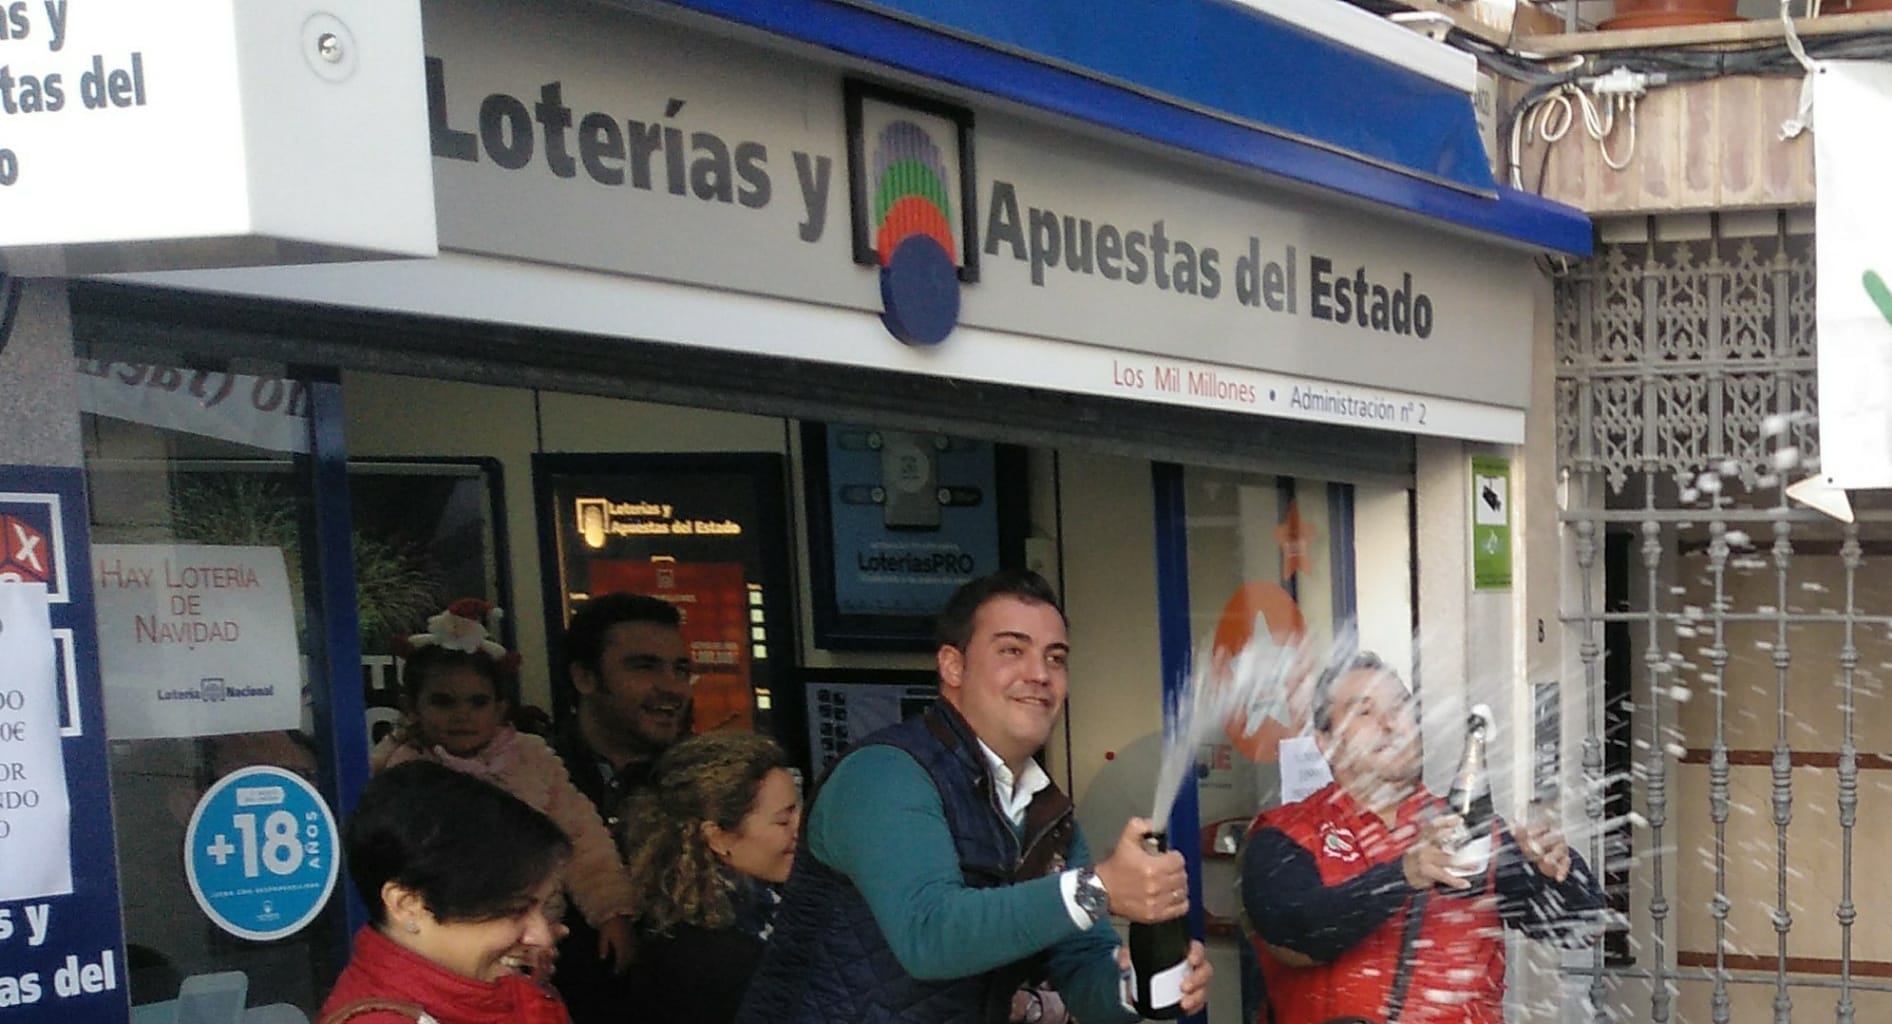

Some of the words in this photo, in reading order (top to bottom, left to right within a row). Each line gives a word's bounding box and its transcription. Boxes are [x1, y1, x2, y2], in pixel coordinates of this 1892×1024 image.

[45, 0, 67, 51] y
[80, 52, 147, 110] del
[425, 56, 772, 209] Loterías
[791, 150, 832, 243] y
[984, 180, 1221, 300] Apuestas
[1235, 236, 1298, 314] del
[1310, 255, 1433, 339] Estado
[1113, 360, 1144, 389] Los
[1154, 366, 1180, 393] Mil
[1188, 370, 1256, 404] Millones
[1290, 386, 1395, 422] Administración
[1418, 403, 1428, 426] 2
[100, 559, 154, 589] HAY
[135, 614, 240, 644] NAVIDAD
[171, 595, 201, 616] DE
[24, 903, 50, 946] y
[54, 949, 117, 998] del
